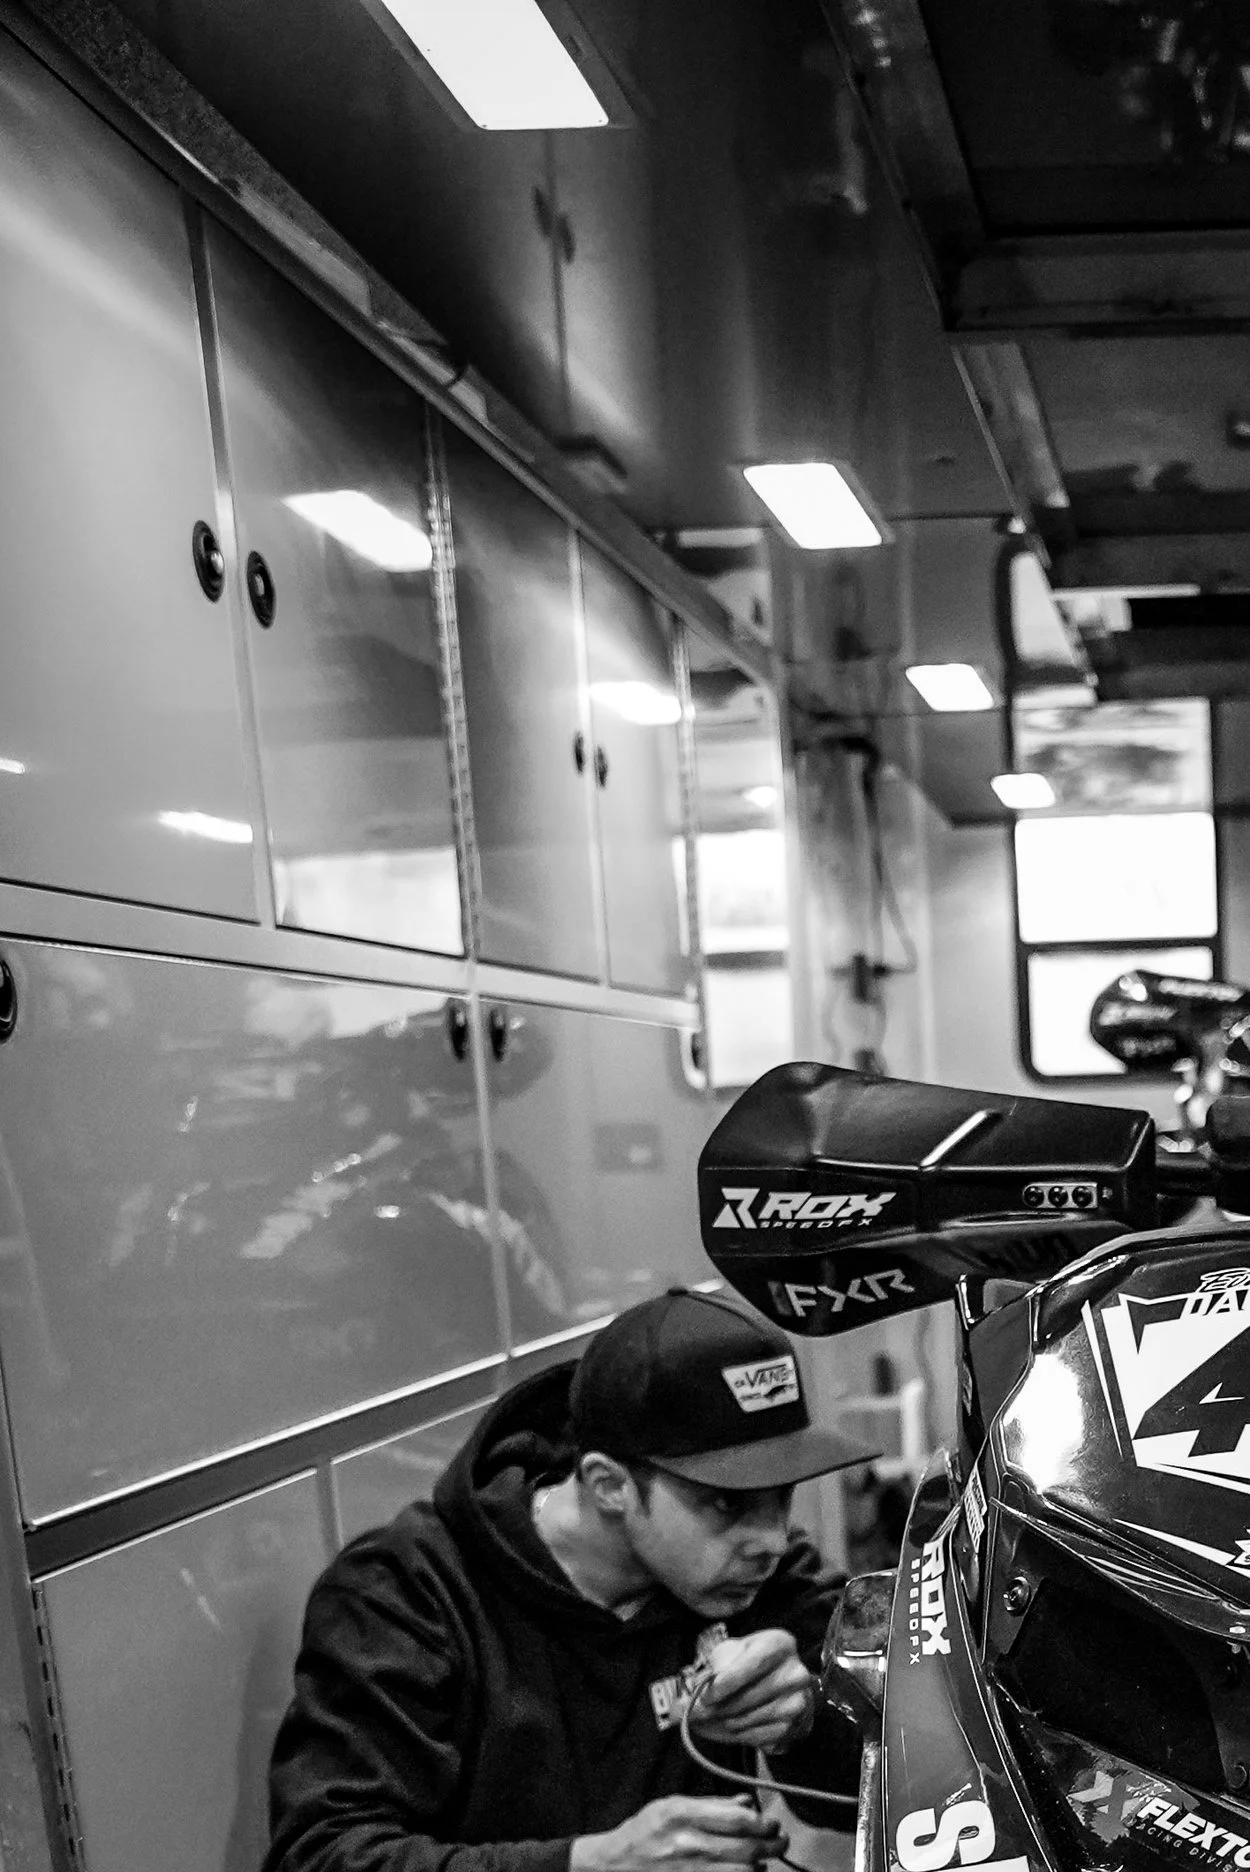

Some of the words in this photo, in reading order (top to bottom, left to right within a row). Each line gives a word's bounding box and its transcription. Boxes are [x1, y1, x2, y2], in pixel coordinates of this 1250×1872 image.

[758, 1190, 898, 1221] ROX
[784, 1267, 917, 1318] FXR
[920, 1539, 952, 1656] ROX
